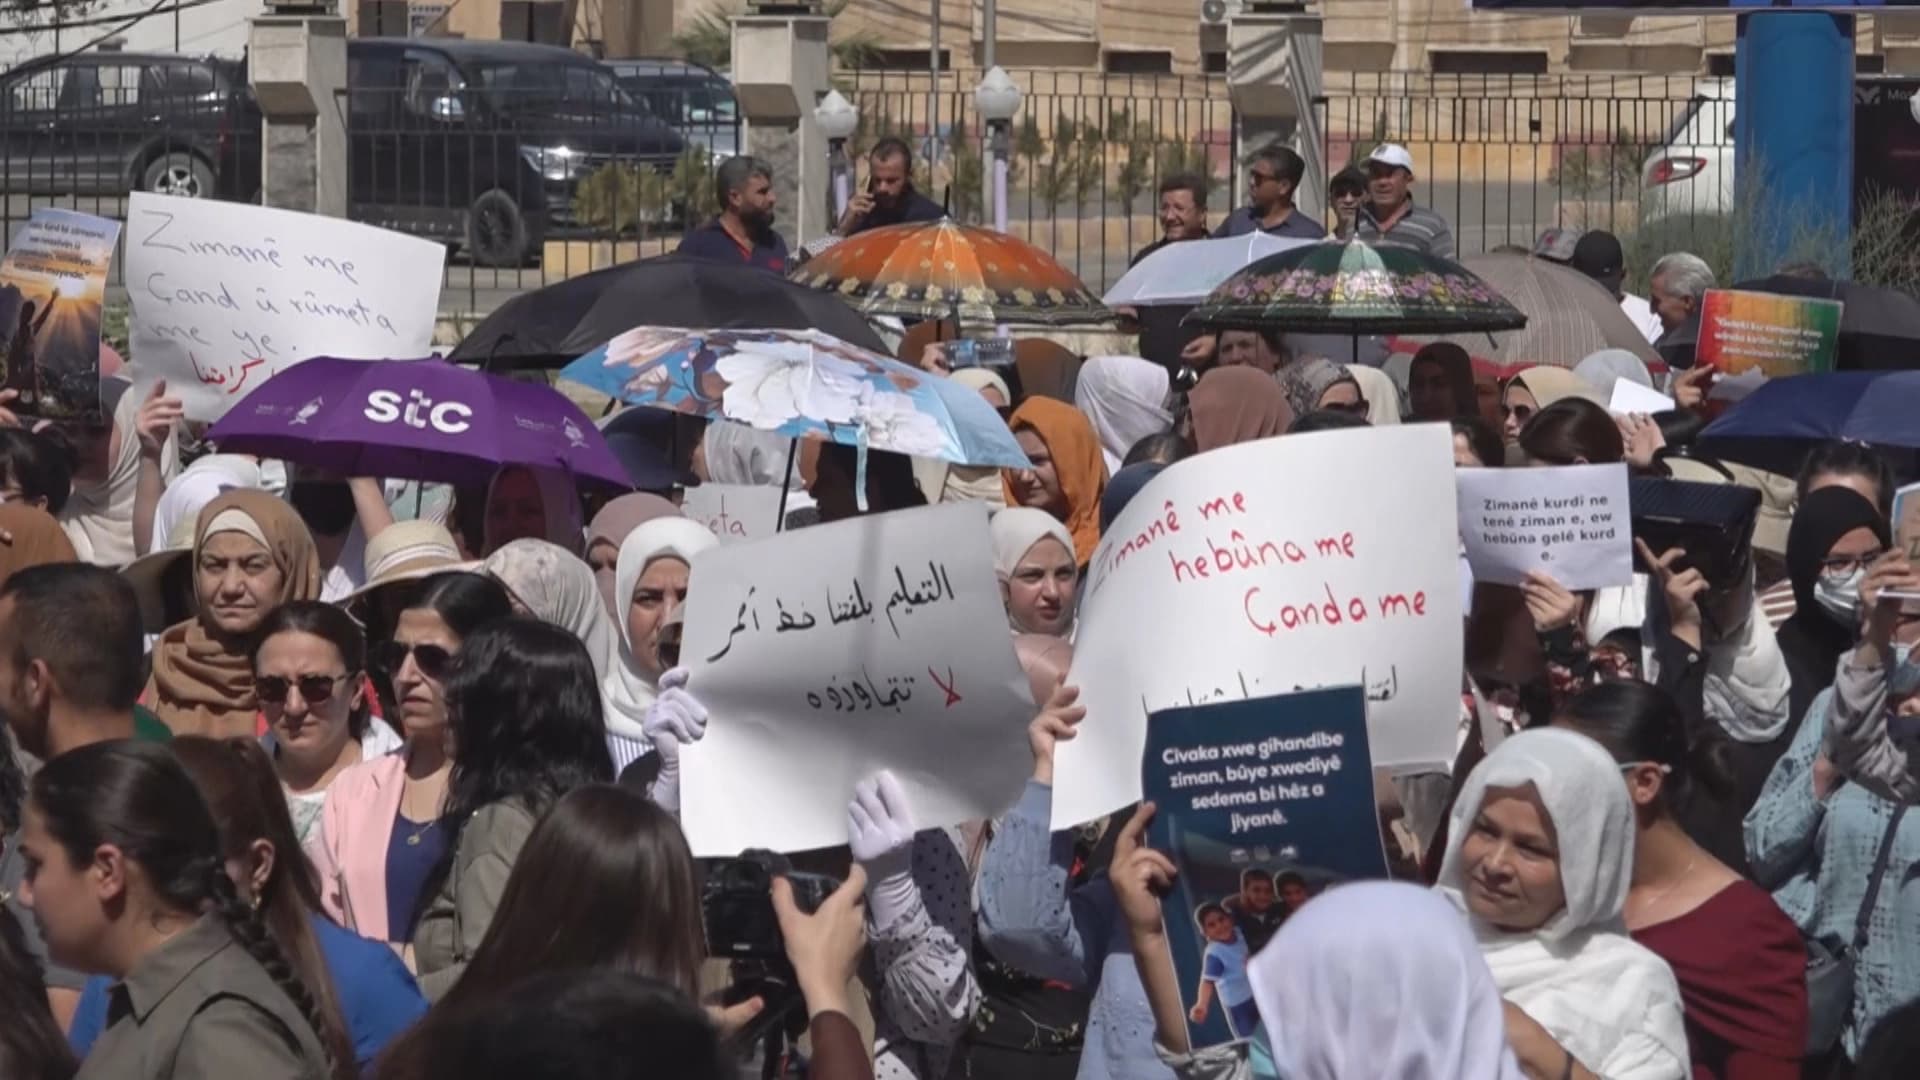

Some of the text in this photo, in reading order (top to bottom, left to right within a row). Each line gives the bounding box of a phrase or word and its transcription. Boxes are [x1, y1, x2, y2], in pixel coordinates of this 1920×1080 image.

[304, 253, 357, 285] me
[147, 272, 240, 312] Çand
[152, 321, 212, 347] me
[363, 388, 473, 433] stc
[1198, 491, 1247, 521] me
[1590, 496, 1608, 506] ne
[1520, 514, 1566, 527] ziman
[1590, 512, 1612, 523] ew
[1580, 528, 1616, 541] kurd
[1168, 529, 1356, 582] hebûna me
[776, 597, 817, 633] خط
[884, 560, 955, 639] التعليم
[1379, 590, 1427, 617] me
[928, 664, 963, 708] لا
[1162, 731, 1344, 765] Civaka xwe gihandibe
[1170, 754, 1342, 789] ziman, bûye xwediyê
[1191, 790, 1257, 810] sedema
[1259, 787, 1276, 802] bi
[1312, 784, 1325, 797] a
[1230, 809, 1288, 834] jiyanê.
